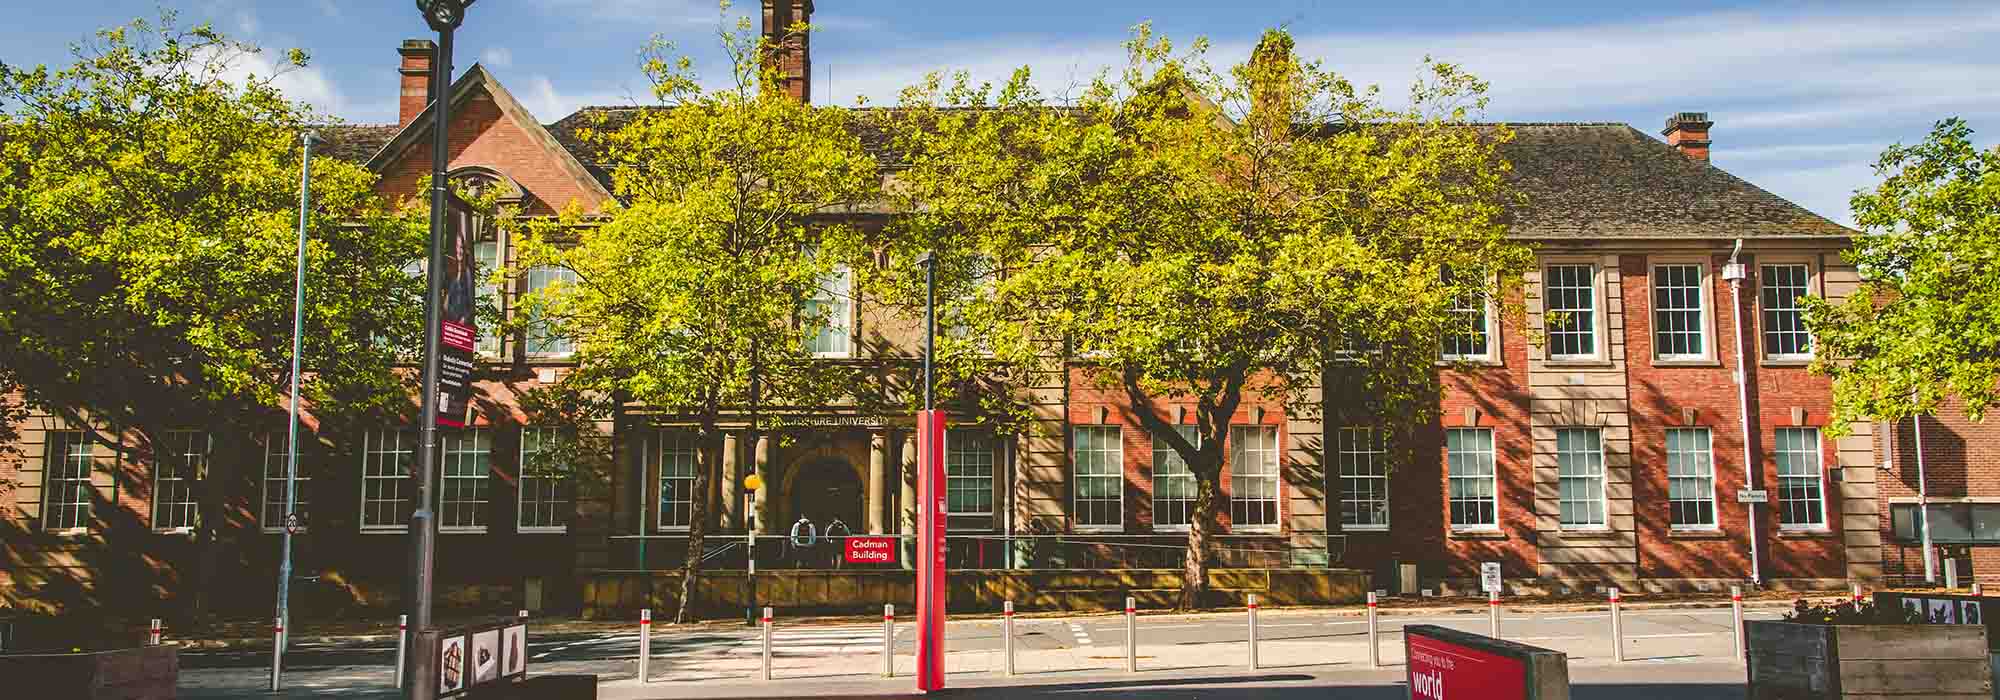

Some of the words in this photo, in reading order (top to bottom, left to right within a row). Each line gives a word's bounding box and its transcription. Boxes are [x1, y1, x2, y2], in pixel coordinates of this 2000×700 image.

[835, 415, 889, 425] UNIVERSITY
[852, 540, 888, 548] Cadman
[852, 550, 888, 561] Building
[1413, 669, 1443, 700] world
